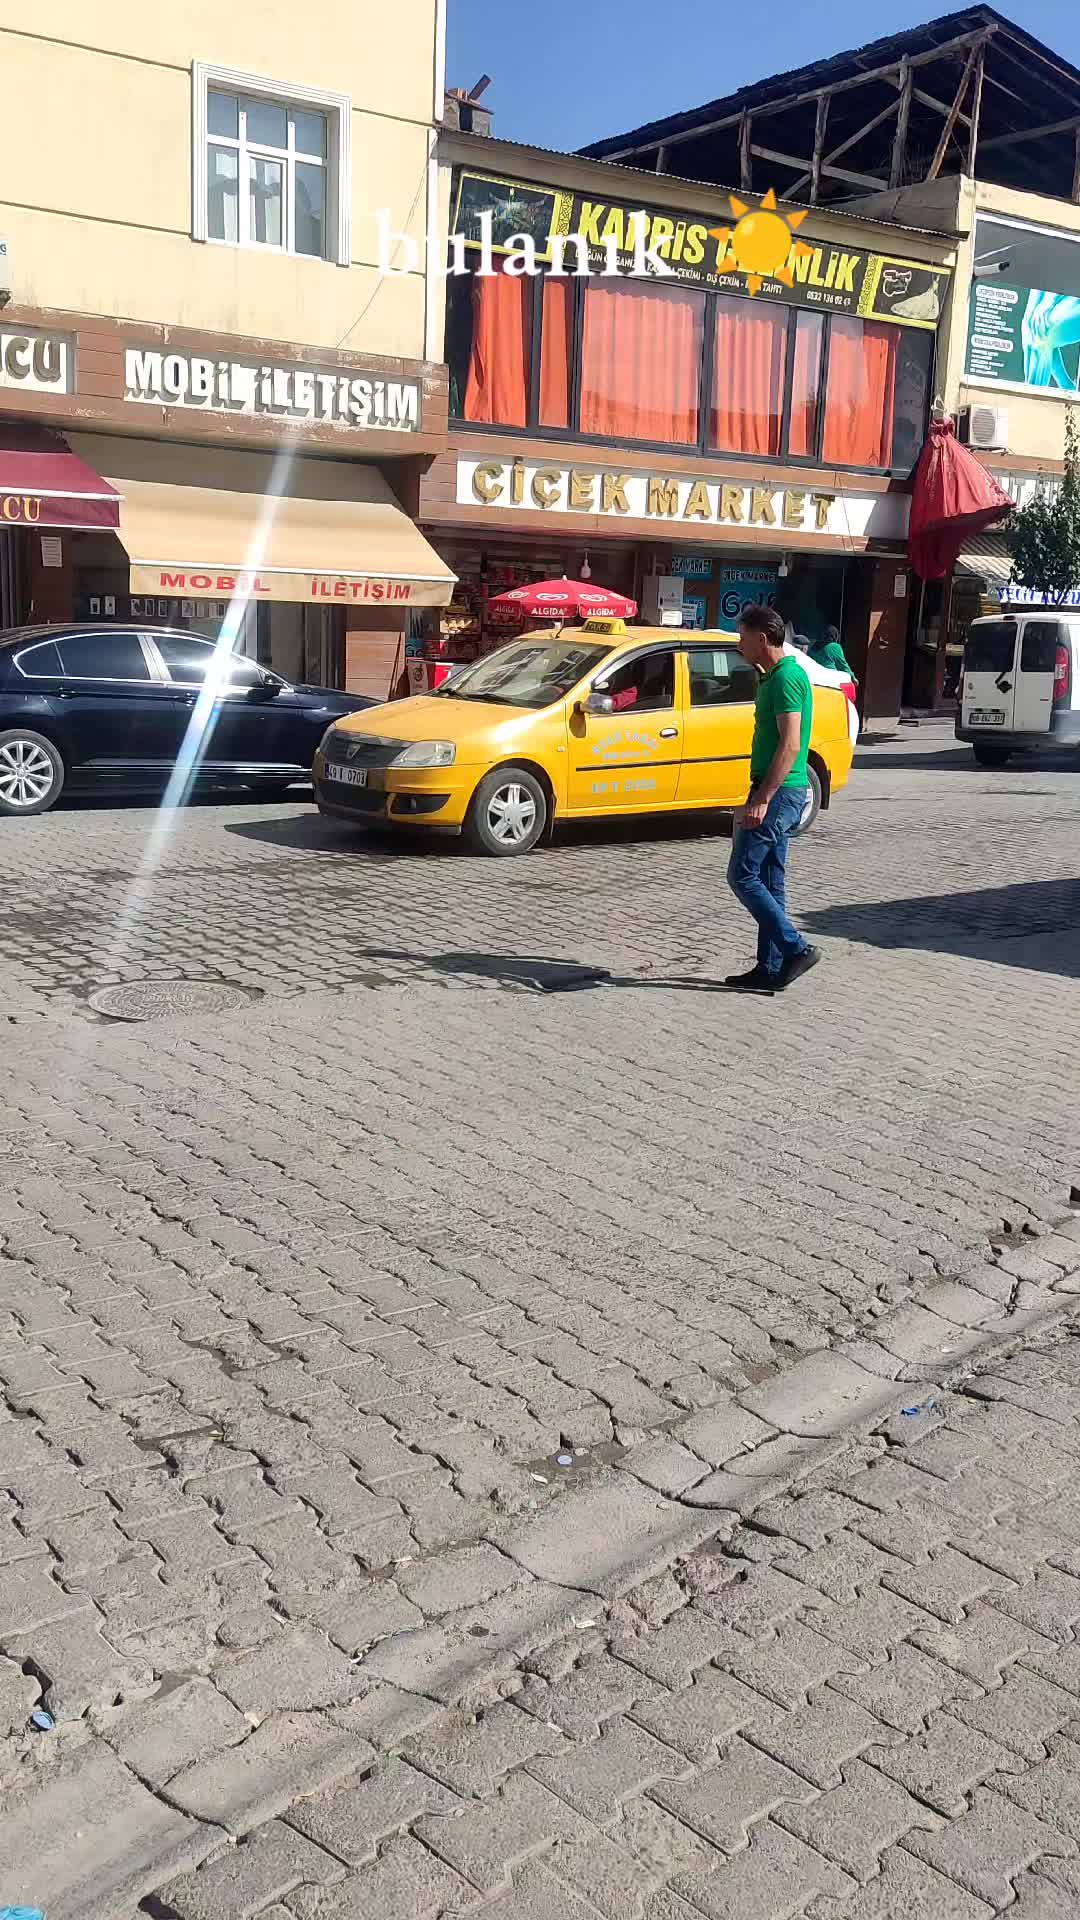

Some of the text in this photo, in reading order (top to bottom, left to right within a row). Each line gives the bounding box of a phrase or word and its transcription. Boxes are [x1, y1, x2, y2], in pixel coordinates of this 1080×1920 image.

[716, 229, 860, 292] NLİK
[0, 334, 62, 383] CU
[125, 349, 418, 424] MOBİL İLETİŞİM
[0, 496, 42, 521] CU
[646, 477, 836, 528] MARKET
[160, 572, 412, 600] MOBL İLETİŞİM
